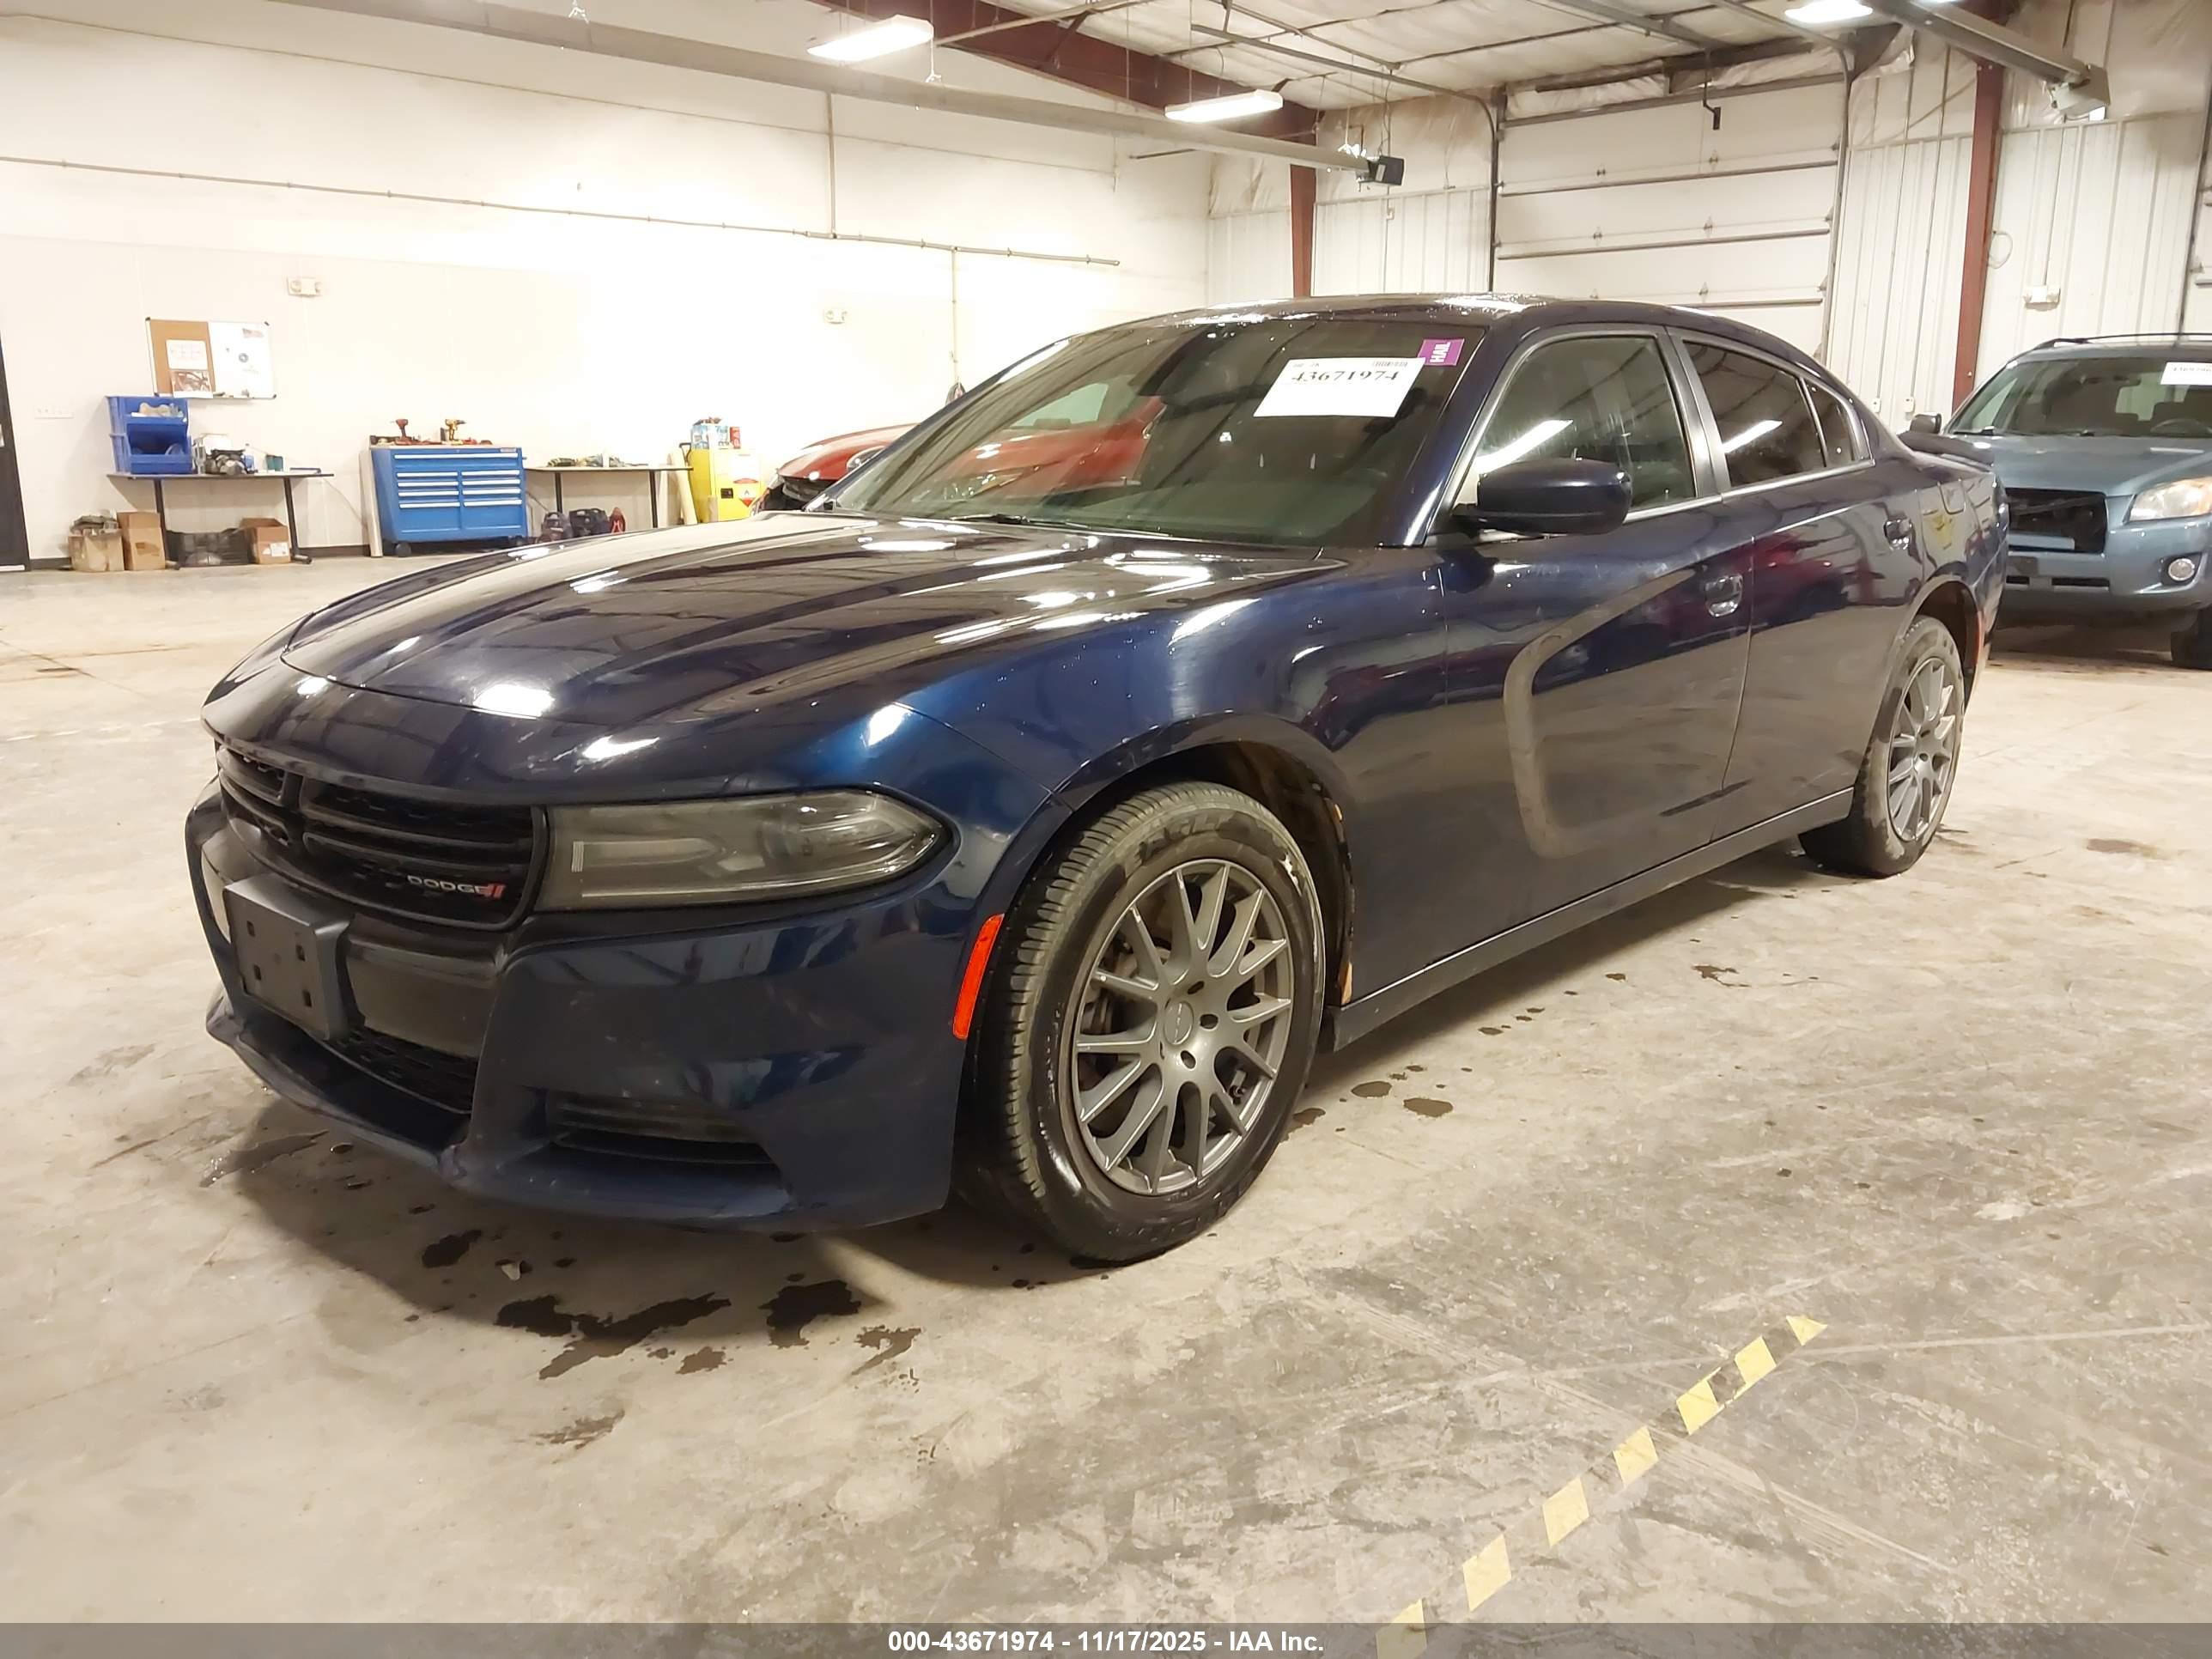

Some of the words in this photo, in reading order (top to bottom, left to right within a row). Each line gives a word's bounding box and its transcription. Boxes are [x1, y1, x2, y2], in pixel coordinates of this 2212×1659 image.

[1430, 343, 1451, 362] HAIL
[1291, 369, 1400, 382] 43671974
[407, 874, 489, 896] DODGE
